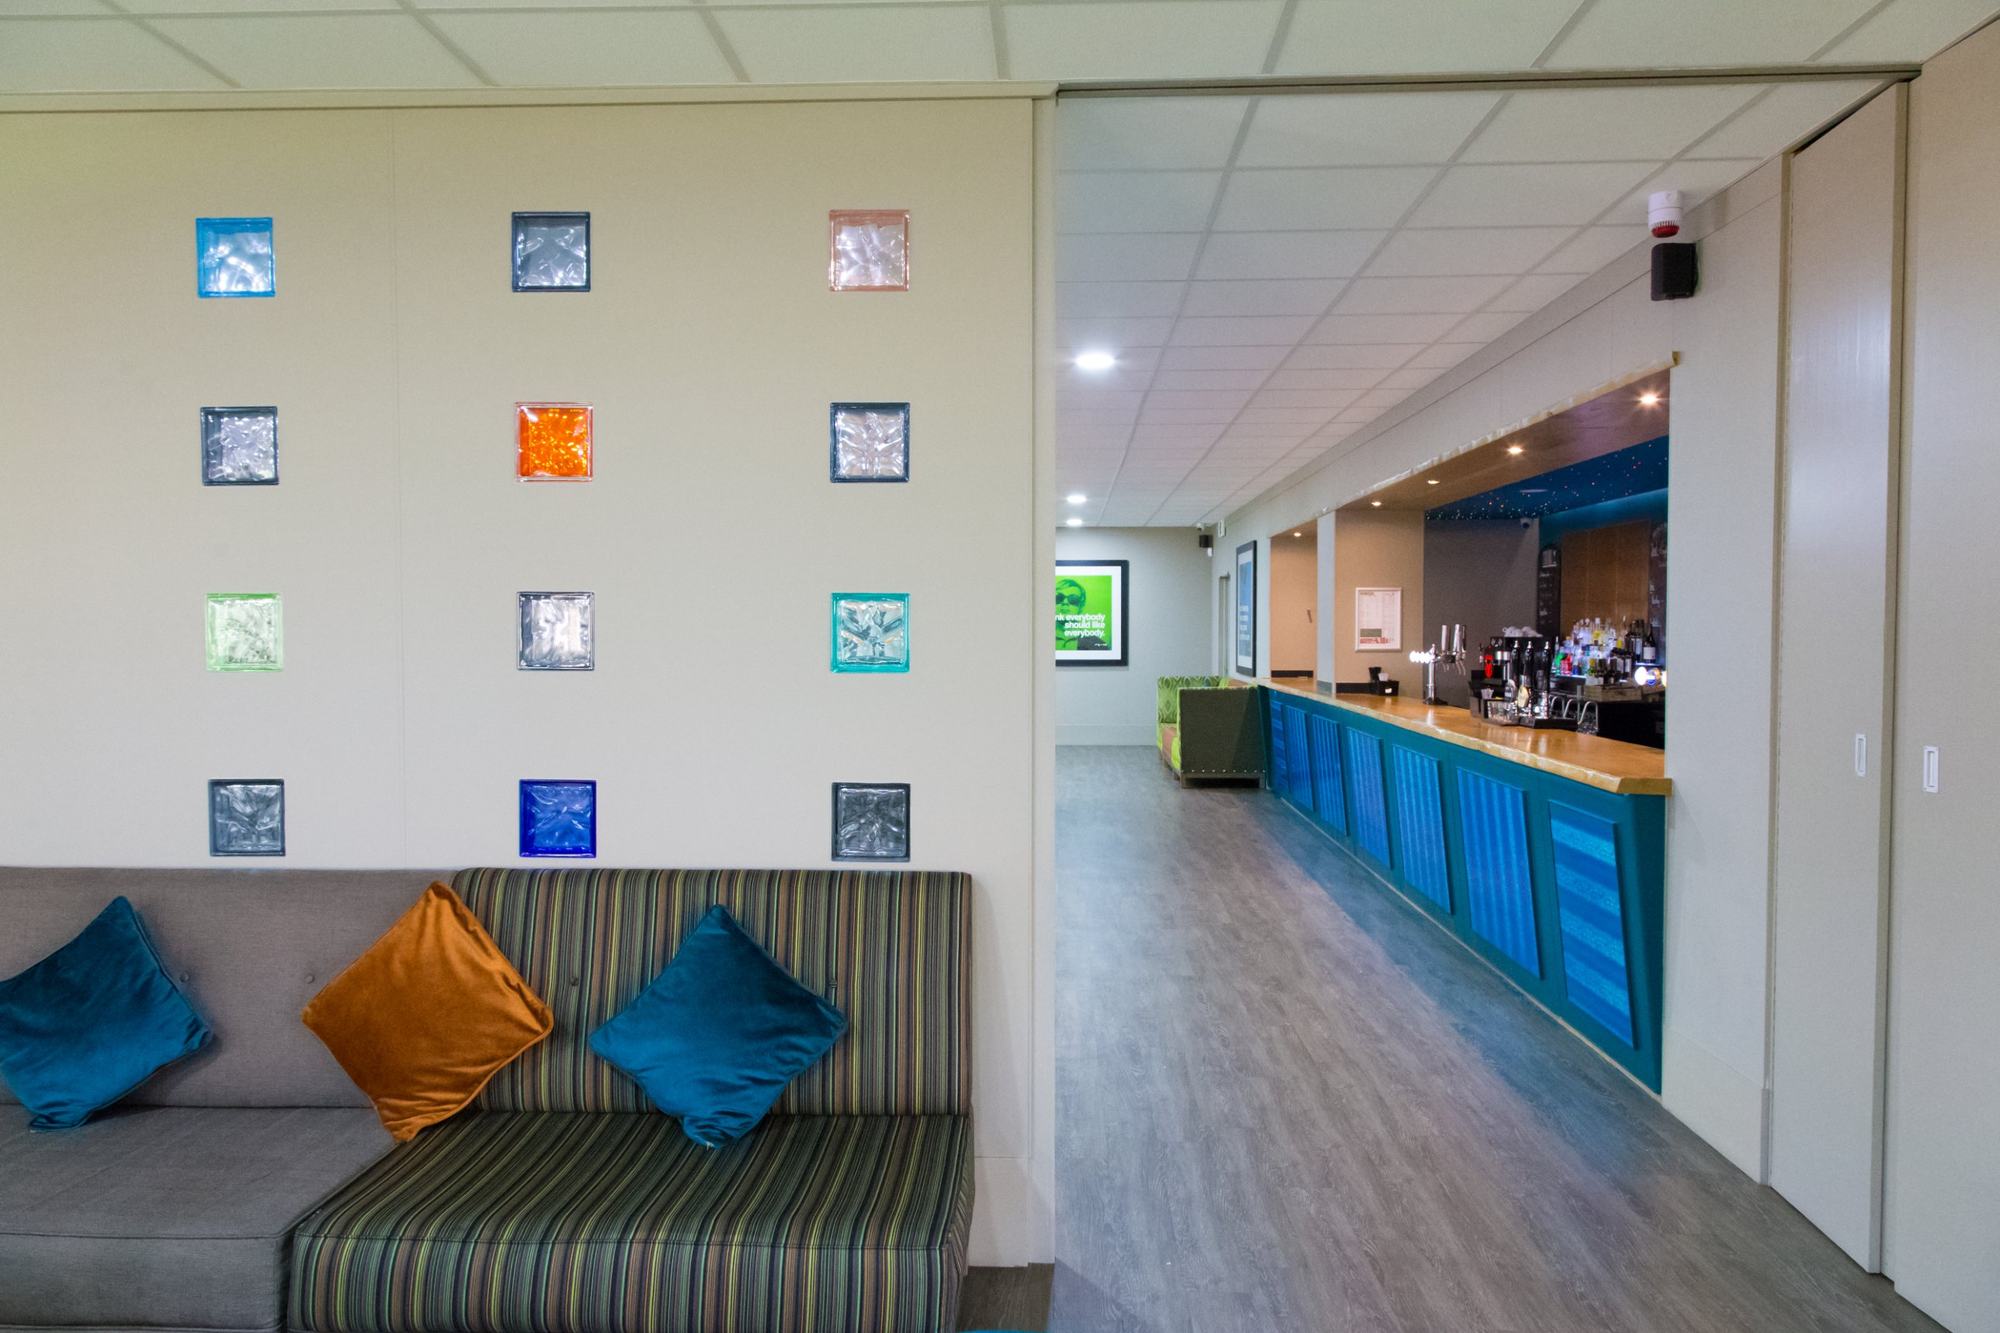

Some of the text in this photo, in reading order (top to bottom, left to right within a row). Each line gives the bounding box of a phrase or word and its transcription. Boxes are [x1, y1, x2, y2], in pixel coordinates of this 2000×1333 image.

[1065, 613, 1105, 622] everybody
[1064, 621, 1105, 629] should like
[1064, 629, 1105, 638] everybody.
